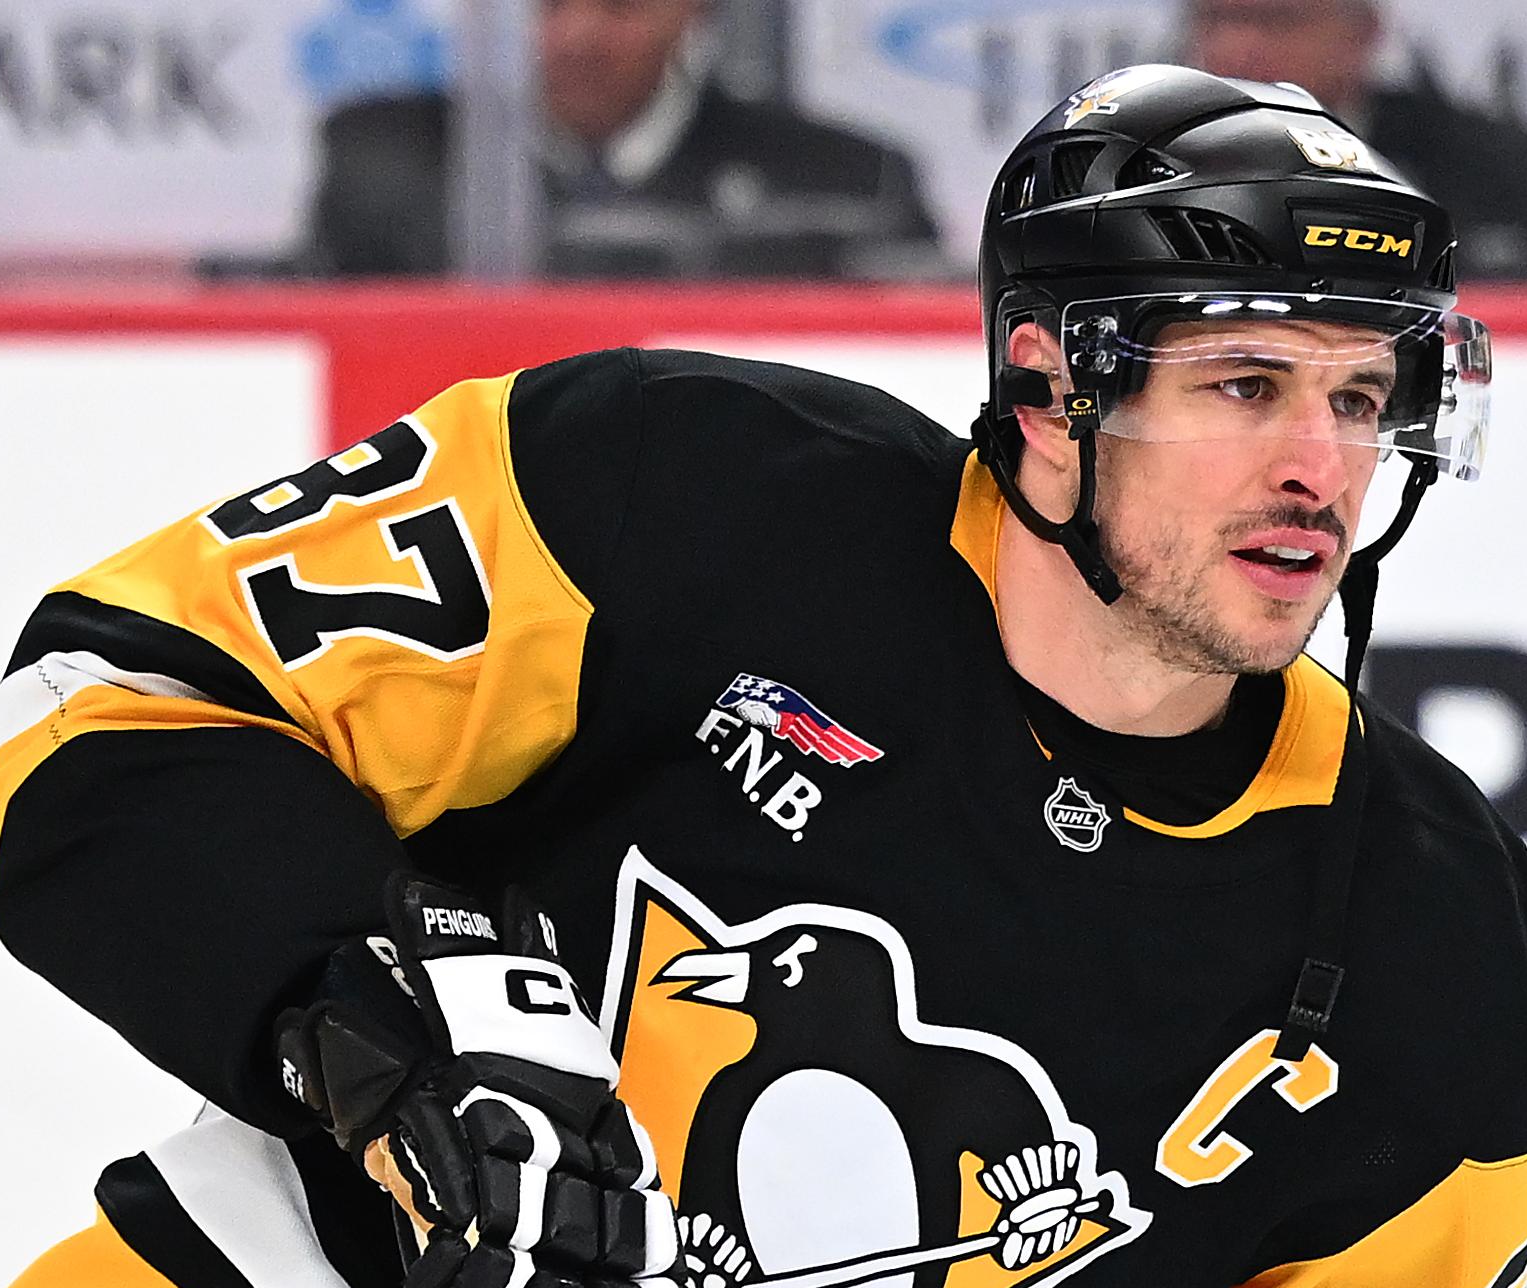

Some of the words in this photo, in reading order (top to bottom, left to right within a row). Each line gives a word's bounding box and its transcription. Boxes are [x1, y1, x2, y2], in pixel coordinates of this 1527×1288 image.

[1303, 224, 1413, 257] CCM
[198, 414, 493, 673] 87
[694, 708, 823, 843] F.N.B.
[1055, 809, 1095, 825] NHL
[1155, 1029, 1338, 1187] C
